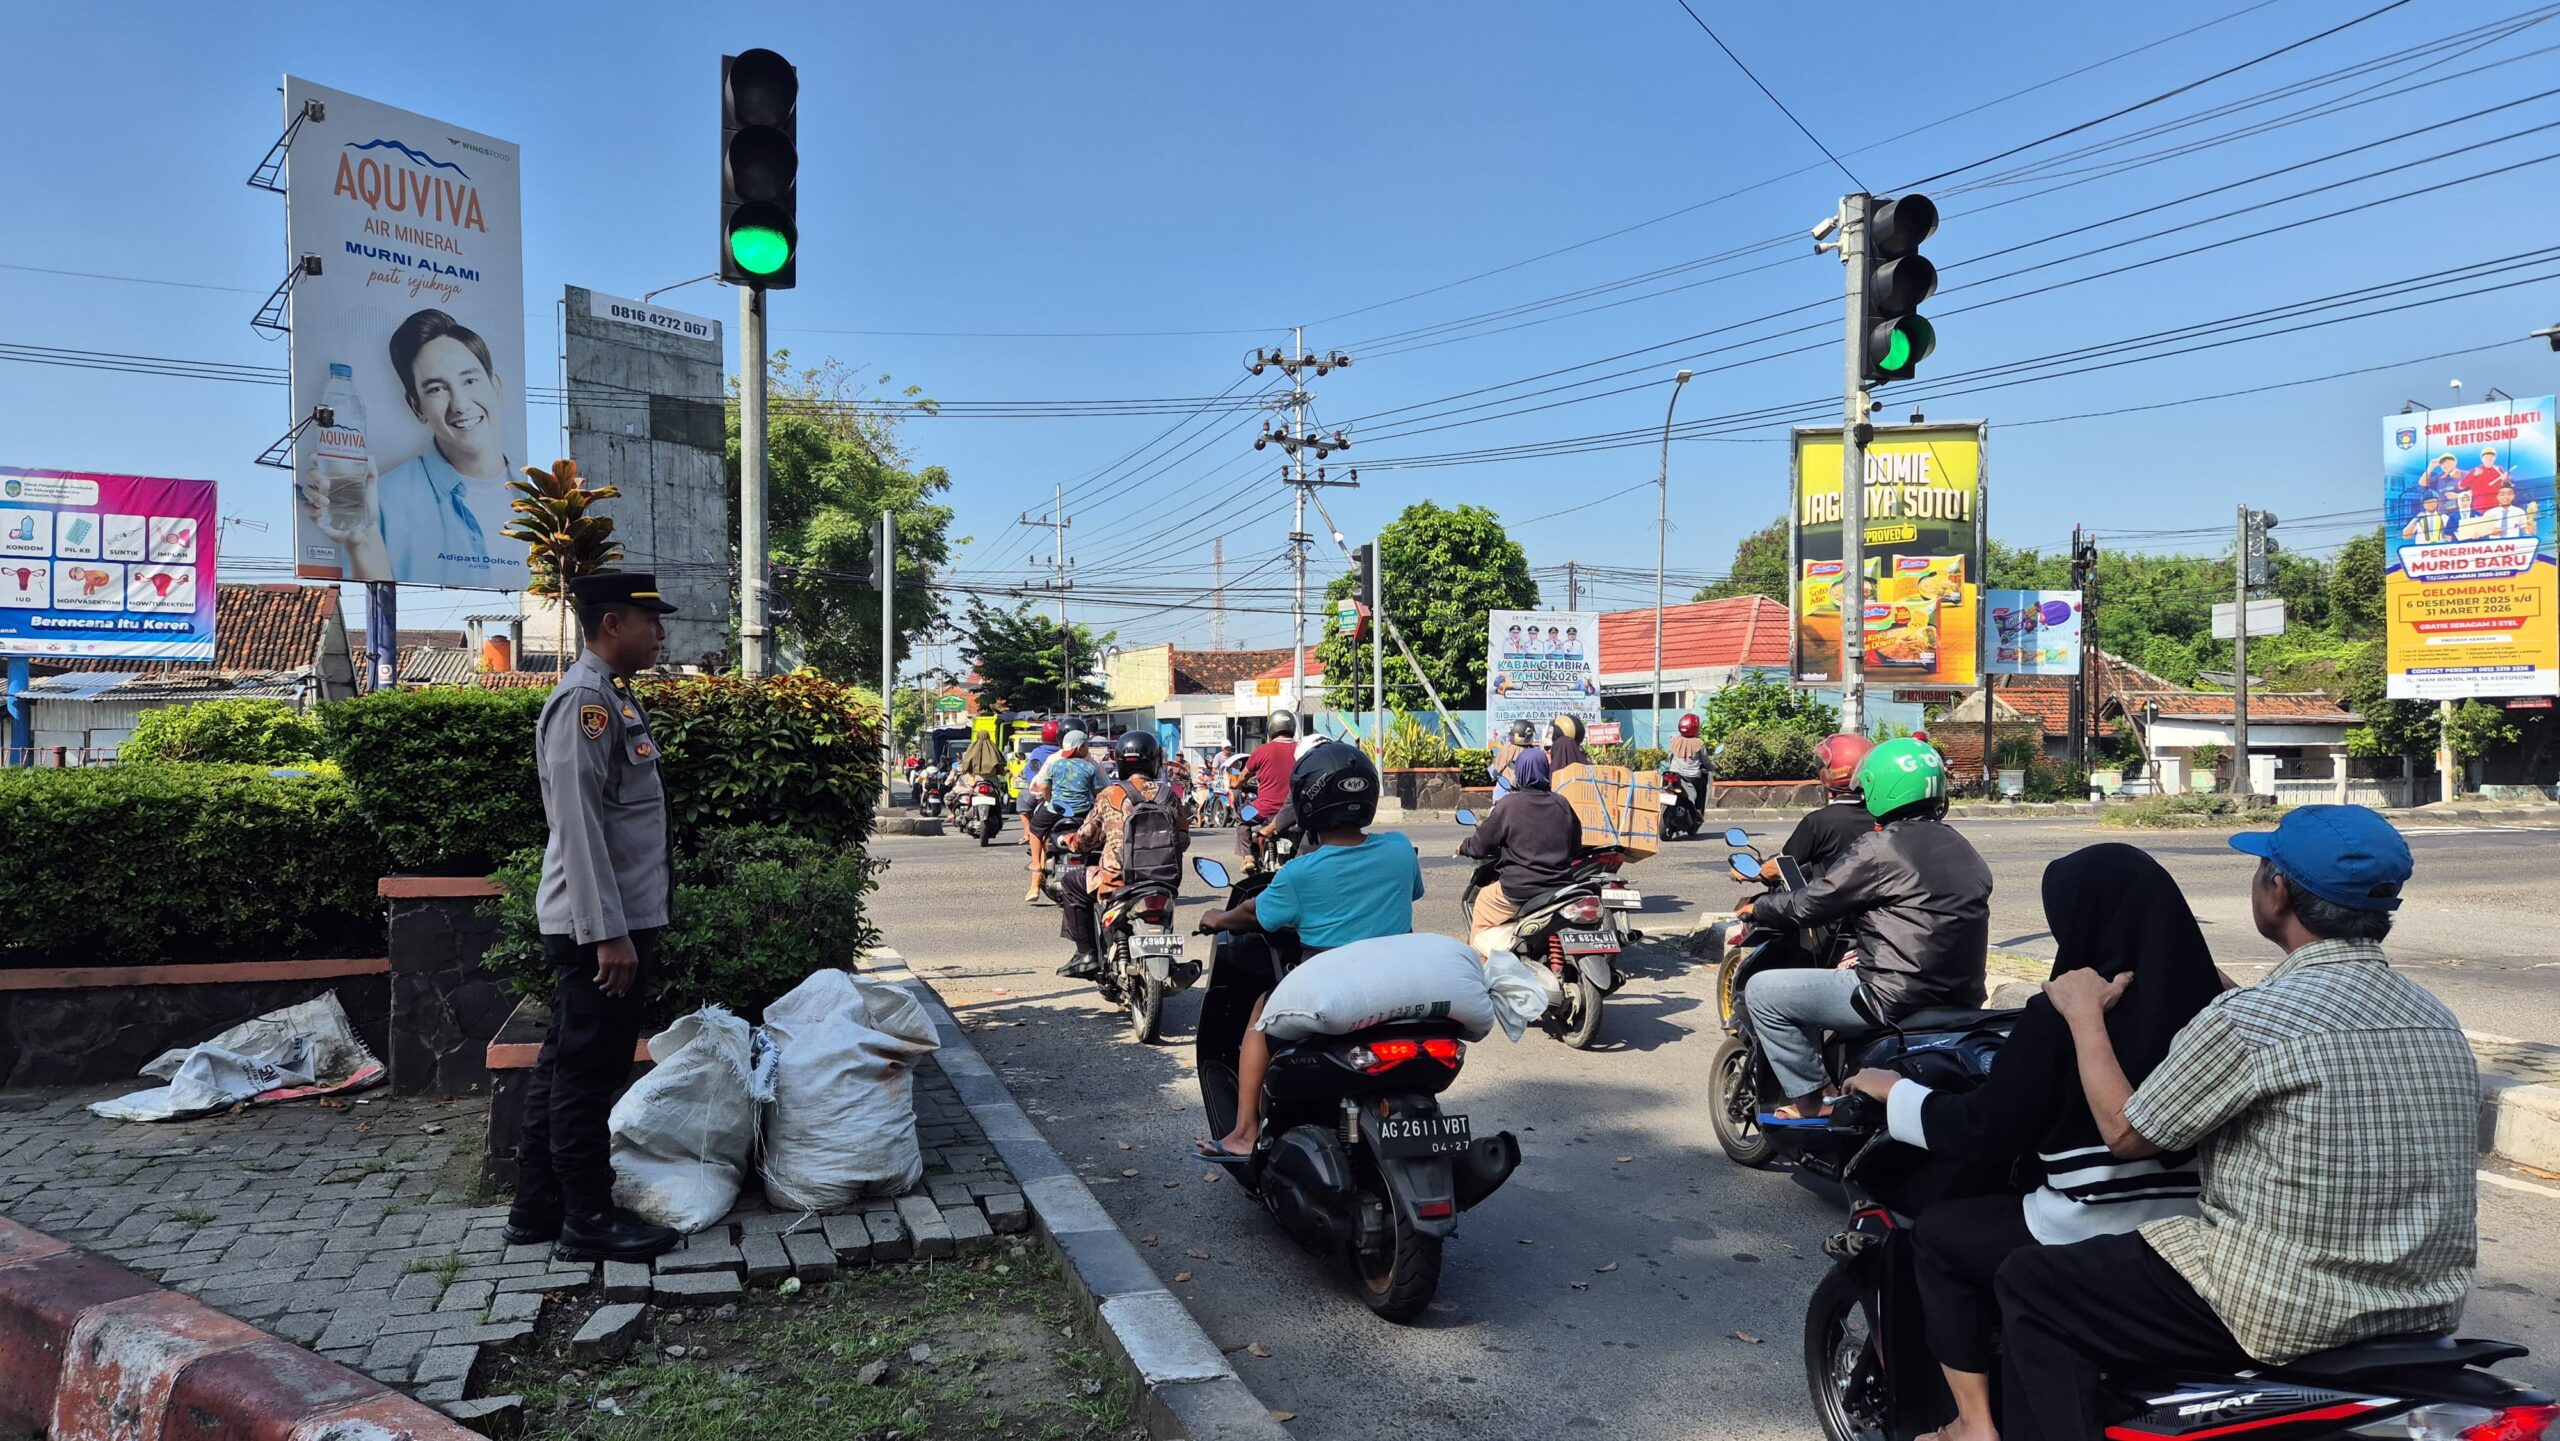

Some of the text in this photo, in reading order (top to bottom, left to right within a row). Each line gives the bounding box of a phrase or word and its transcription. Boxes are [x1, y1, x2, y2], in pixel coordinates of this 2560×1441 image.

[462, 142, 510, 162] WINGSFOOD
[333, 151, 486, 233] AQUVIVA
[364, 217, 463, 256] AIR MINERAL
[345, 241, 480, 282] MURNI ALAMI
[366, 268, 462, 303] pasti sejuknya
[611, 304, 708, 337] 0816 4272 067
[2425, 411, 2541, 436] SMK TARUNA BAKTI
[320, 430, 366, 449] AQUVIVA
[2446, 428, 2518, 446] KERTOSONO
[1864, 452, 1931, 485] DOMIE
[1904, 489, 1970, 522] SOTO!
[1864, 528, 1901, 542] PROVED
[2421, 544, 2515, 558] PENERIMAAN
[437, 552, 521, 567] Adipati Dolken
[2412, 555, 2526, 573] MURID BARU
[1810, 587, 1828, 597] Soto
[2422, 584, 2515, 598] GELOMBANG 1
[57, 598, 121, 606] MOP/VASEKTOMI
[1811, 596, 1825, 606] Mie
[2417, 597, 2480, 608] DESEMBER
[2484, 596, 2511, 605] 2025
[2514, 594, 2532, 603] s/d
[2426, 604, 2512, 616] 31 MARET 2026
[31, 616, 190, 630] Berencana Itu Keren
[2419, 623, 2449, 631] GRATIS
[2450, 621, 2490, 630] SERAGAM
[1498, 661, 1590, 671] KABAR GEMBIRA
[1511, 671, 1578, 681] TAHUN 2026
[1496, 711, 1523, 719] TIDAK
[1131, 937, 1141, 946] AG
[1565, 934, 1575, 943] AG
[1381, 1117, 1467, 1139] AG 2611 VBT
